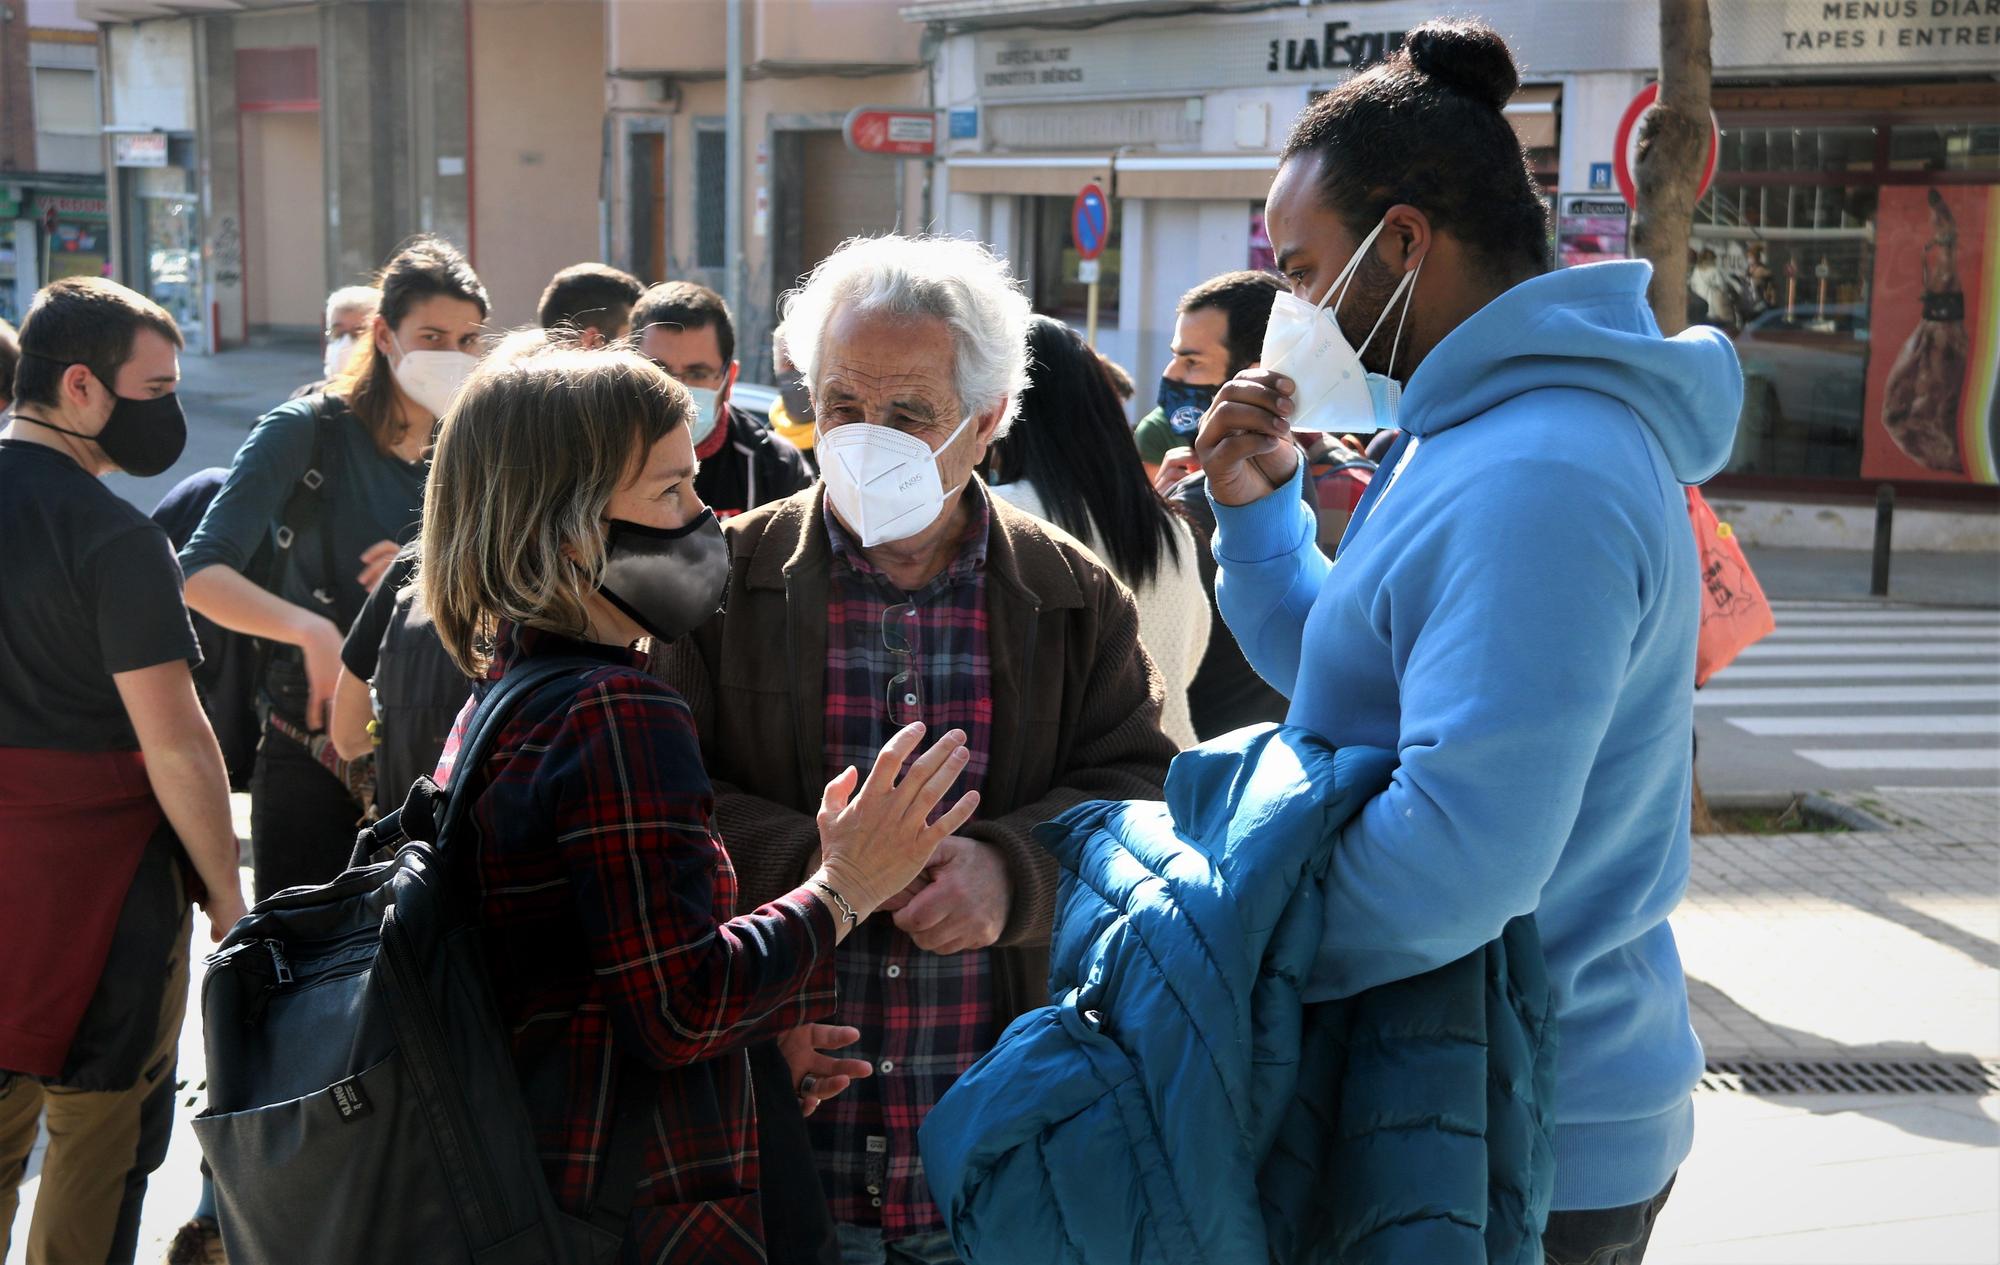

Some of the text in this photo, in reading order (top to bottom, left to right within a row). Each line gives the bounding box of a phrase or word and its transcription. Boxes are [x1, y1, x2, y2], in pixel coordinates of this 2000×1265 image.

[1823, 2, 1918, 20] MENUS
[1783, 30, 1865, 49] TAPES
[1878, 31, 1884, 46] I
[1285, 38, 1320, 70] LA
[899, 472, 923, 493] KN95
